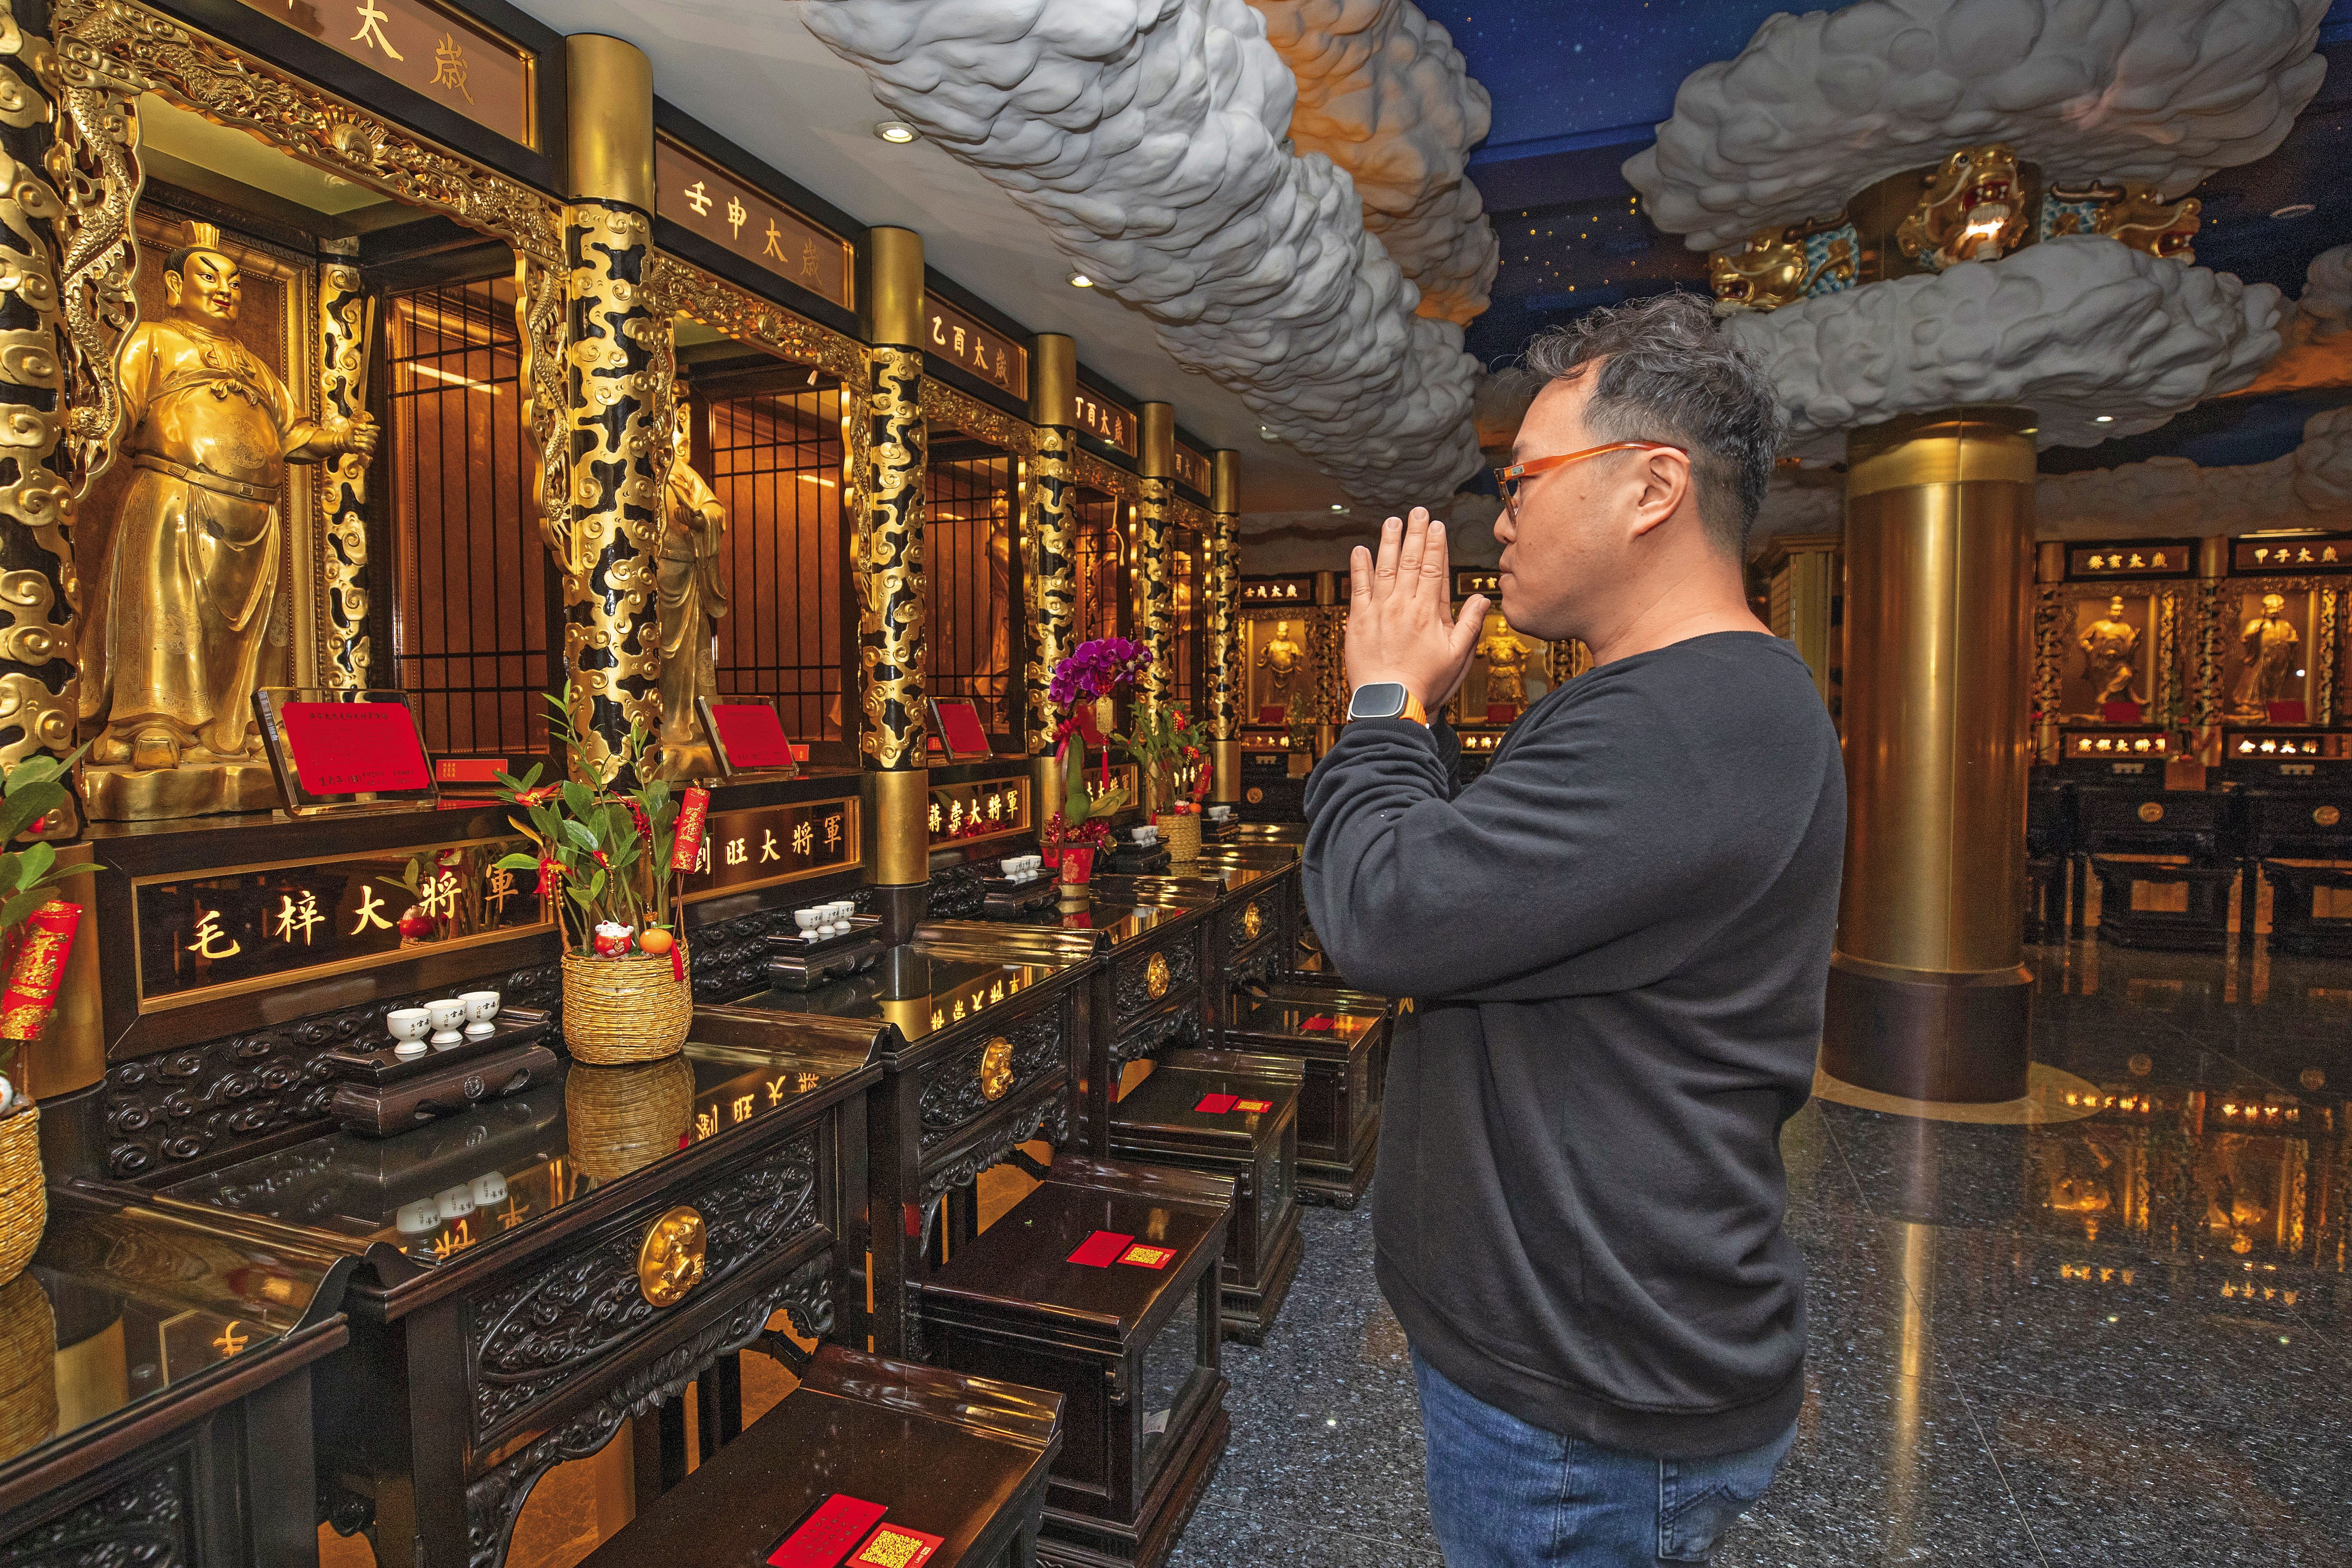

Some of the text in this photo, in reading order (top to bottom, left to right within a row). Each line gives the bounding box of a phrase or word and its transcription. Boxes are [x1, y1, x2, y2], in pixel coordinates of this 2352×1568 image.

[288, 0, 474, 106] 太歲
[684, 181, 823, 285] 壬申太歲
[932, 316, 1008, 384] 乙酉太歲
[1075, 397, 1124, 445] 丁酉太歲
[2254, 546, 2339, 564] 甲子太歲
[929, 790, 1018, 833] 蔣崇大將軍
[186, 864, 518, 959] 毛梓大將軍
